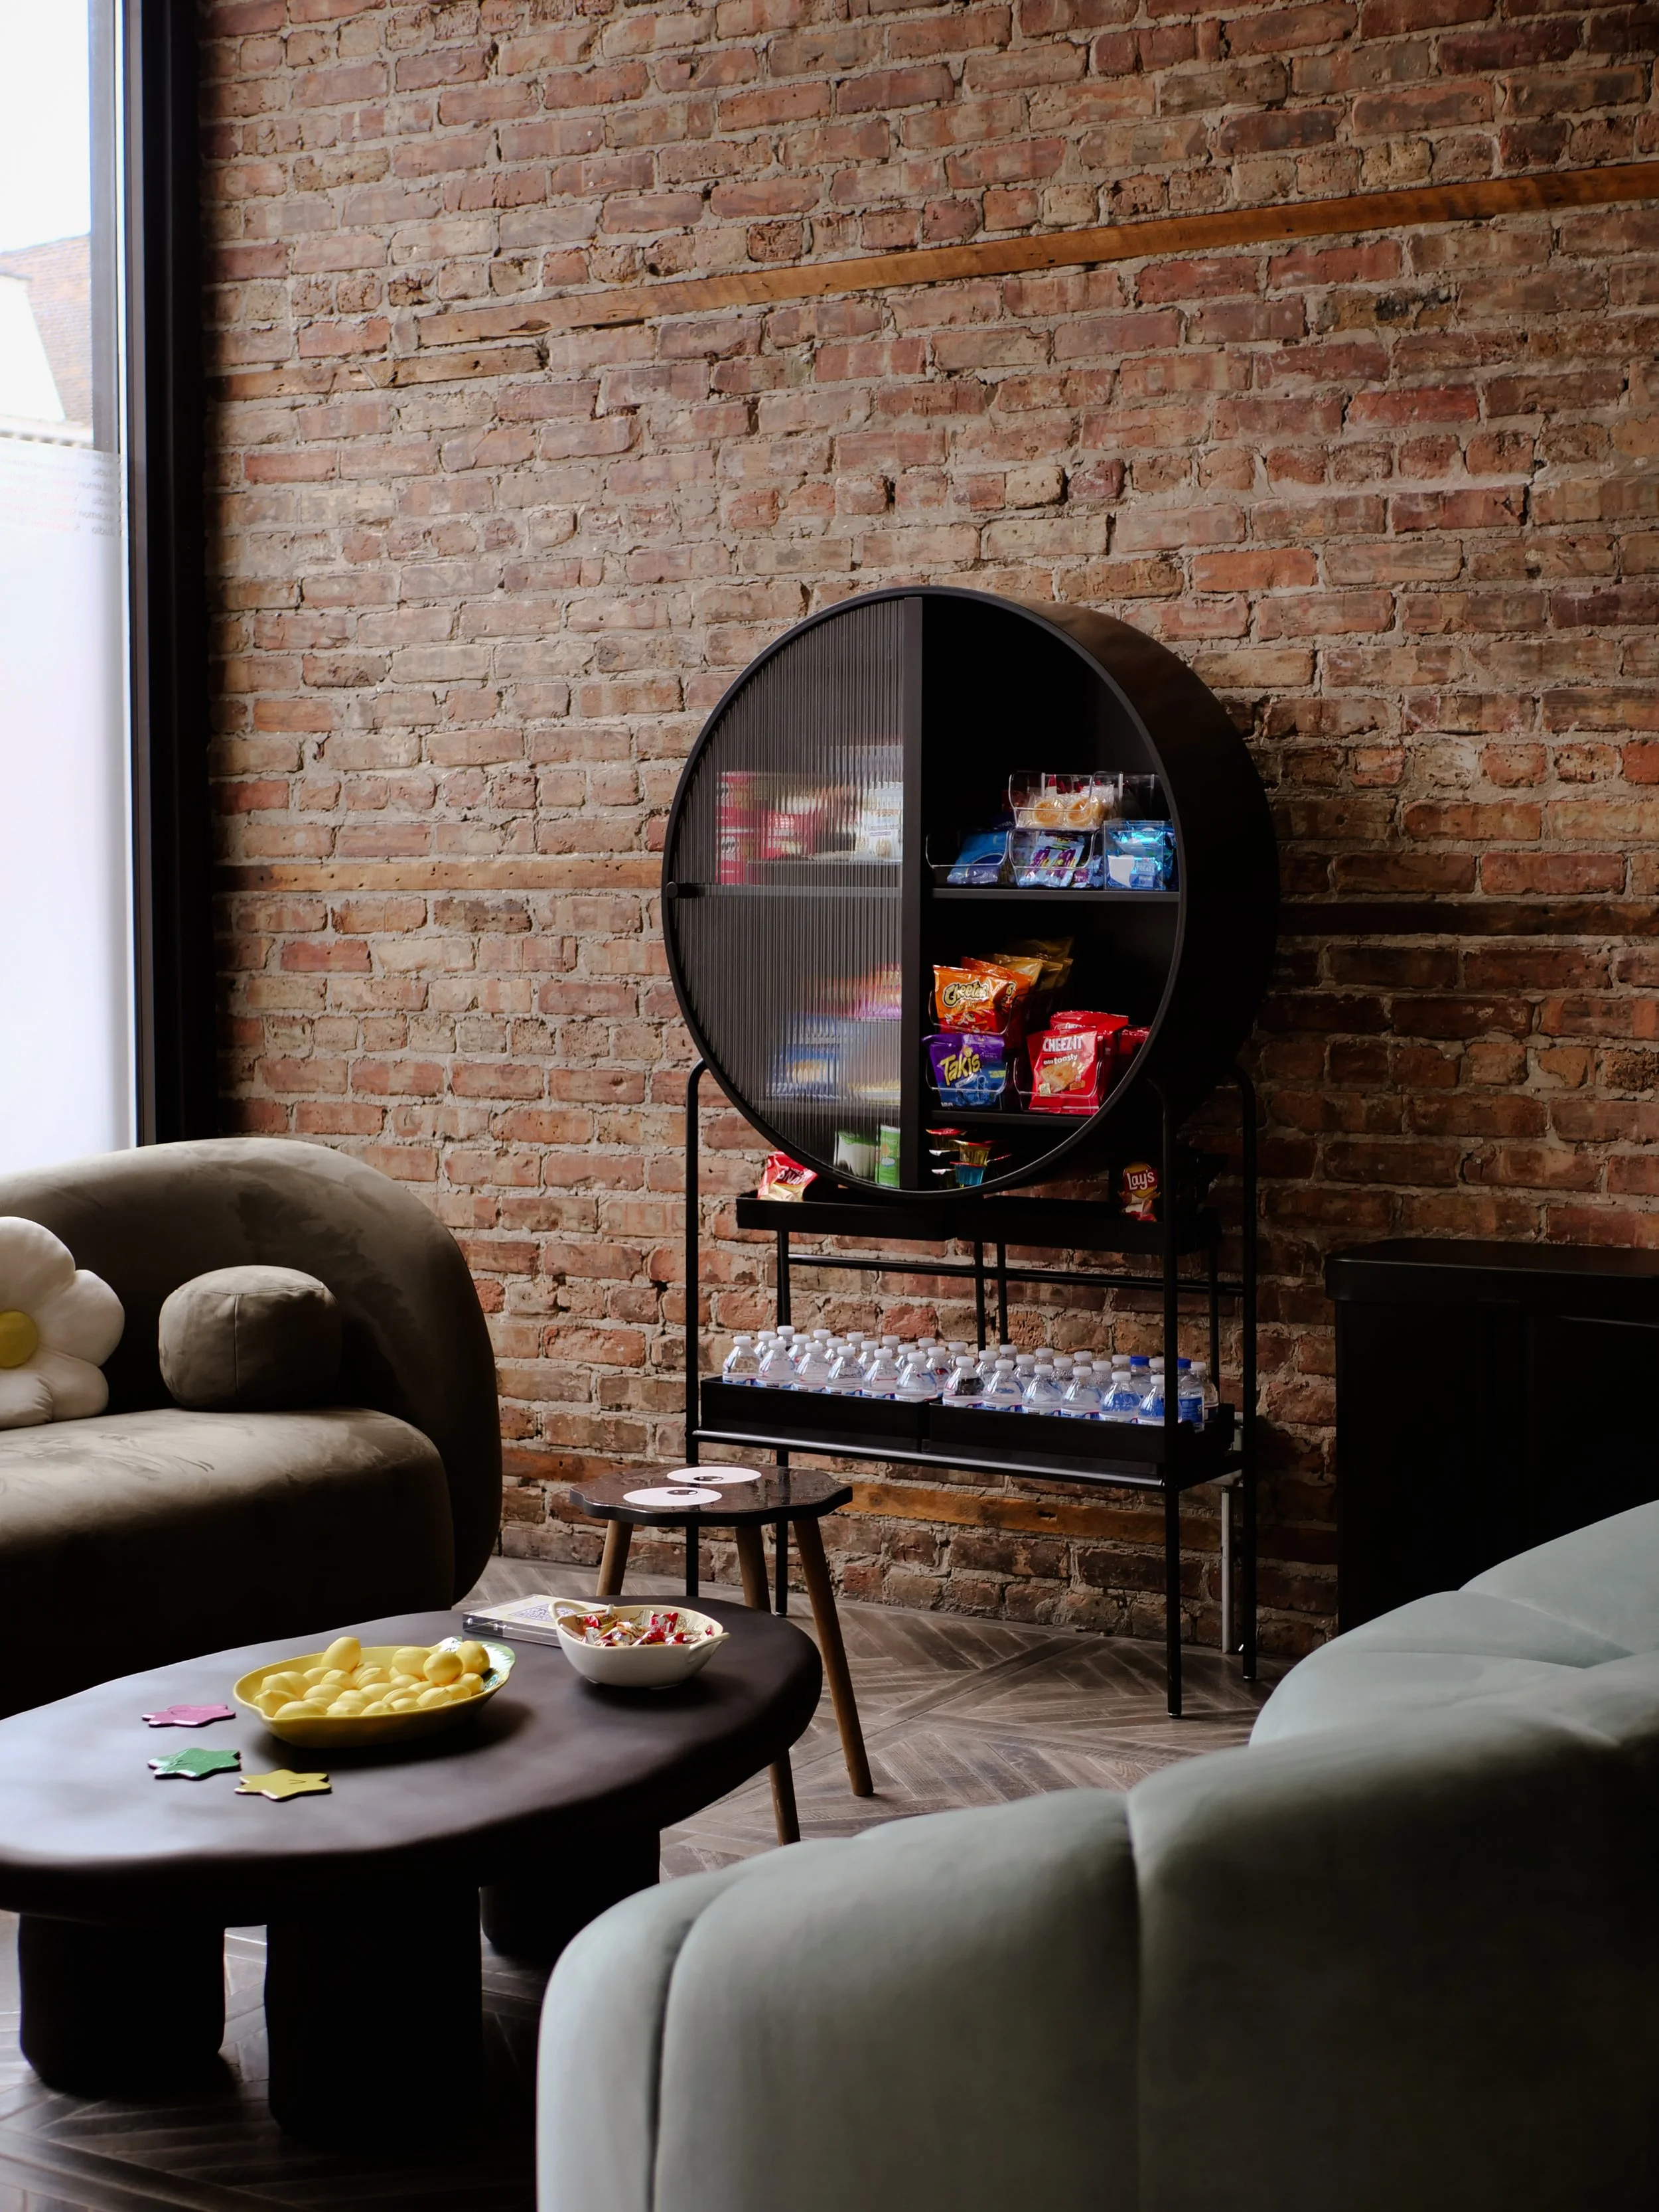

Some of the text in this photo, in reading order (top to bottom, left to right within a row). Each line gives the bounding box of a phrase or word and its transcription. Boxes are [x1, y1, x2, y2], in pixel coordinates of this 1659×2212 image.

[944, 981, 988, 1007] Cheetos
[939, 1047, 981, 1086] Takis
[1054, 1054, 1078, 1065] toasty
[1126, 1169, 1155, 1191] Lay's
